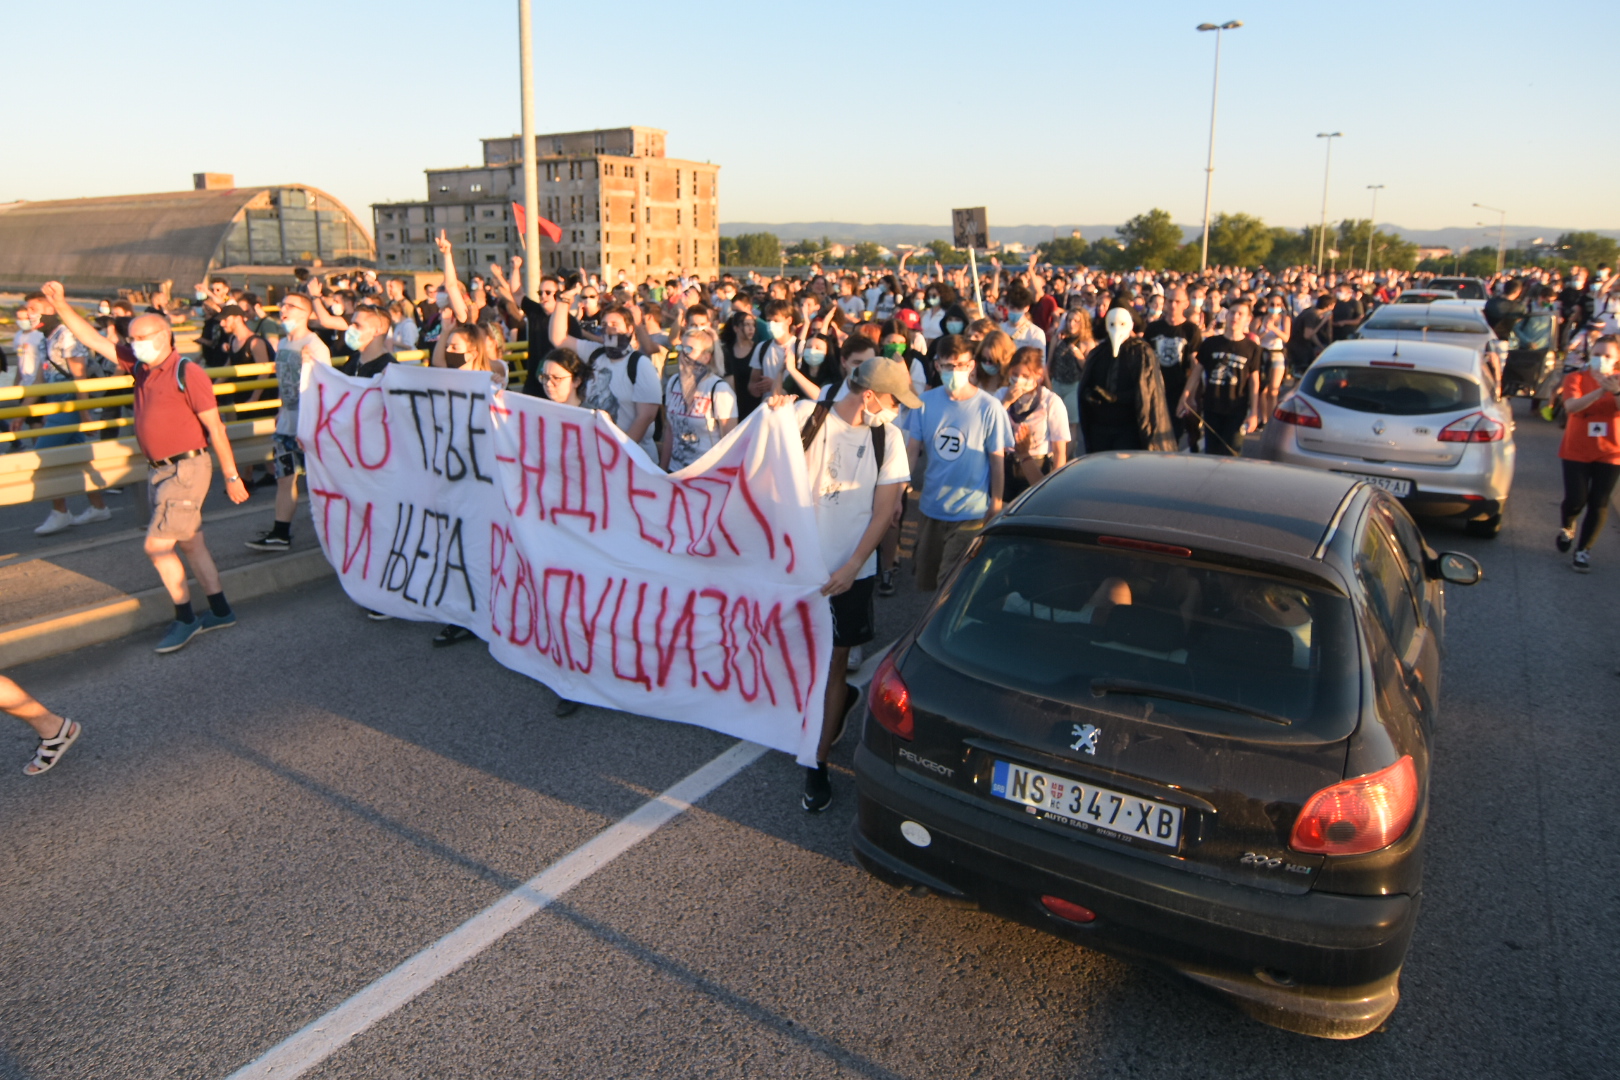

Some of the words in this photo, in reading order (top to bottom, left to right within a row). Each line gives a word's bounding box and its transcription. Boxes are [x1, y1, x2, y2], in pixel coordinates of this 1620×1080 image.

[313, 383, 391, 470] КО
[389, 389, 493, 484] ТЕБЕ
[939, 434, 961, 453] 73
[312, 488, 373, 580] ТИ
[380, 502, 477, 612] ЊЕГА
[899, 747, 955, 778] PEUGEOT
[1011, 769, 1046, 804] NS
[1044, 811, 1068, 825] AUTO
[1069, 818, 1089, 831] RAD
[1240, 852, 1282, 868] 206
